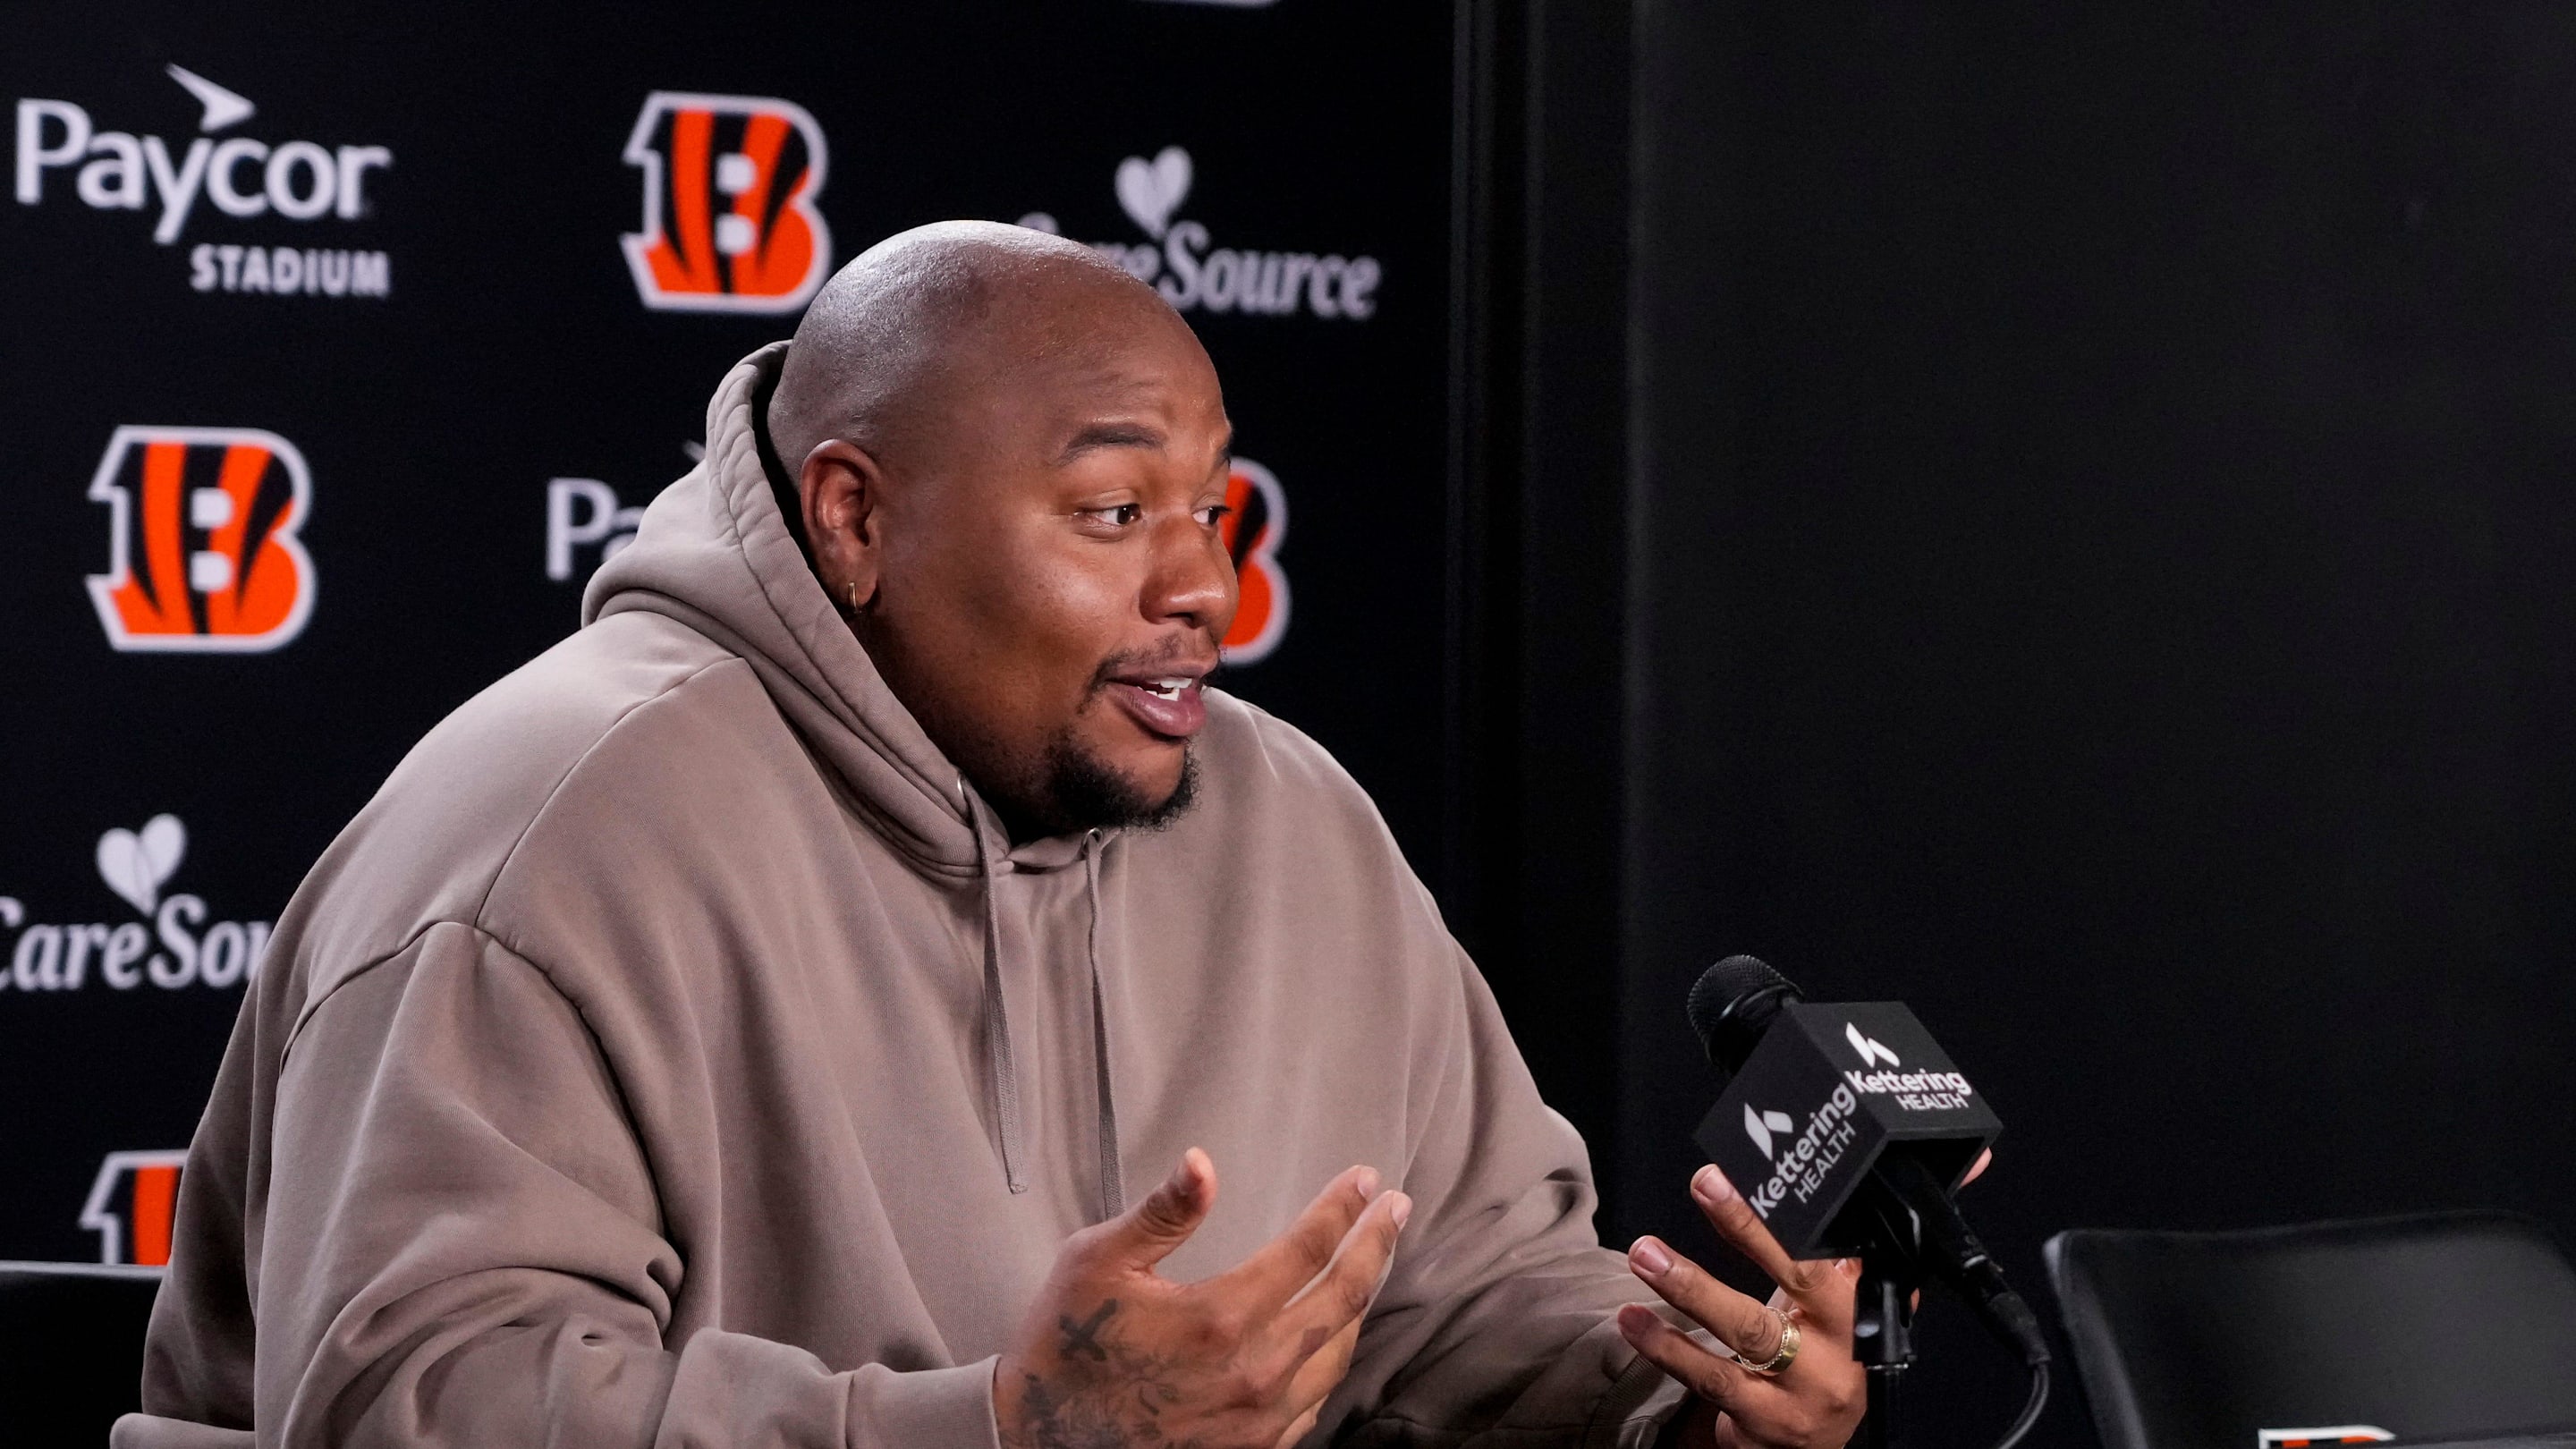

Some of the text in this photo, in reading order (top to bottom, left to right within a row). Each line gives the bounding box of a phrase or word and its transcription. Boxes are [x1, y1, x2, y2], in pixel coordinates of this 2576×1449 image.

[16, 97, 393, 245] Paycor
[190, 242, 391, 298] STADIUM
[86, 425, 317, 653] B
[1843, 1068, 1974, 1096] Kettering
[1894, 1092, 1970, 1112] HEALTH
[1749, 1081, 1857, 1220] Kettering
[1793, 1120, 1857, 1204] HEALTH
